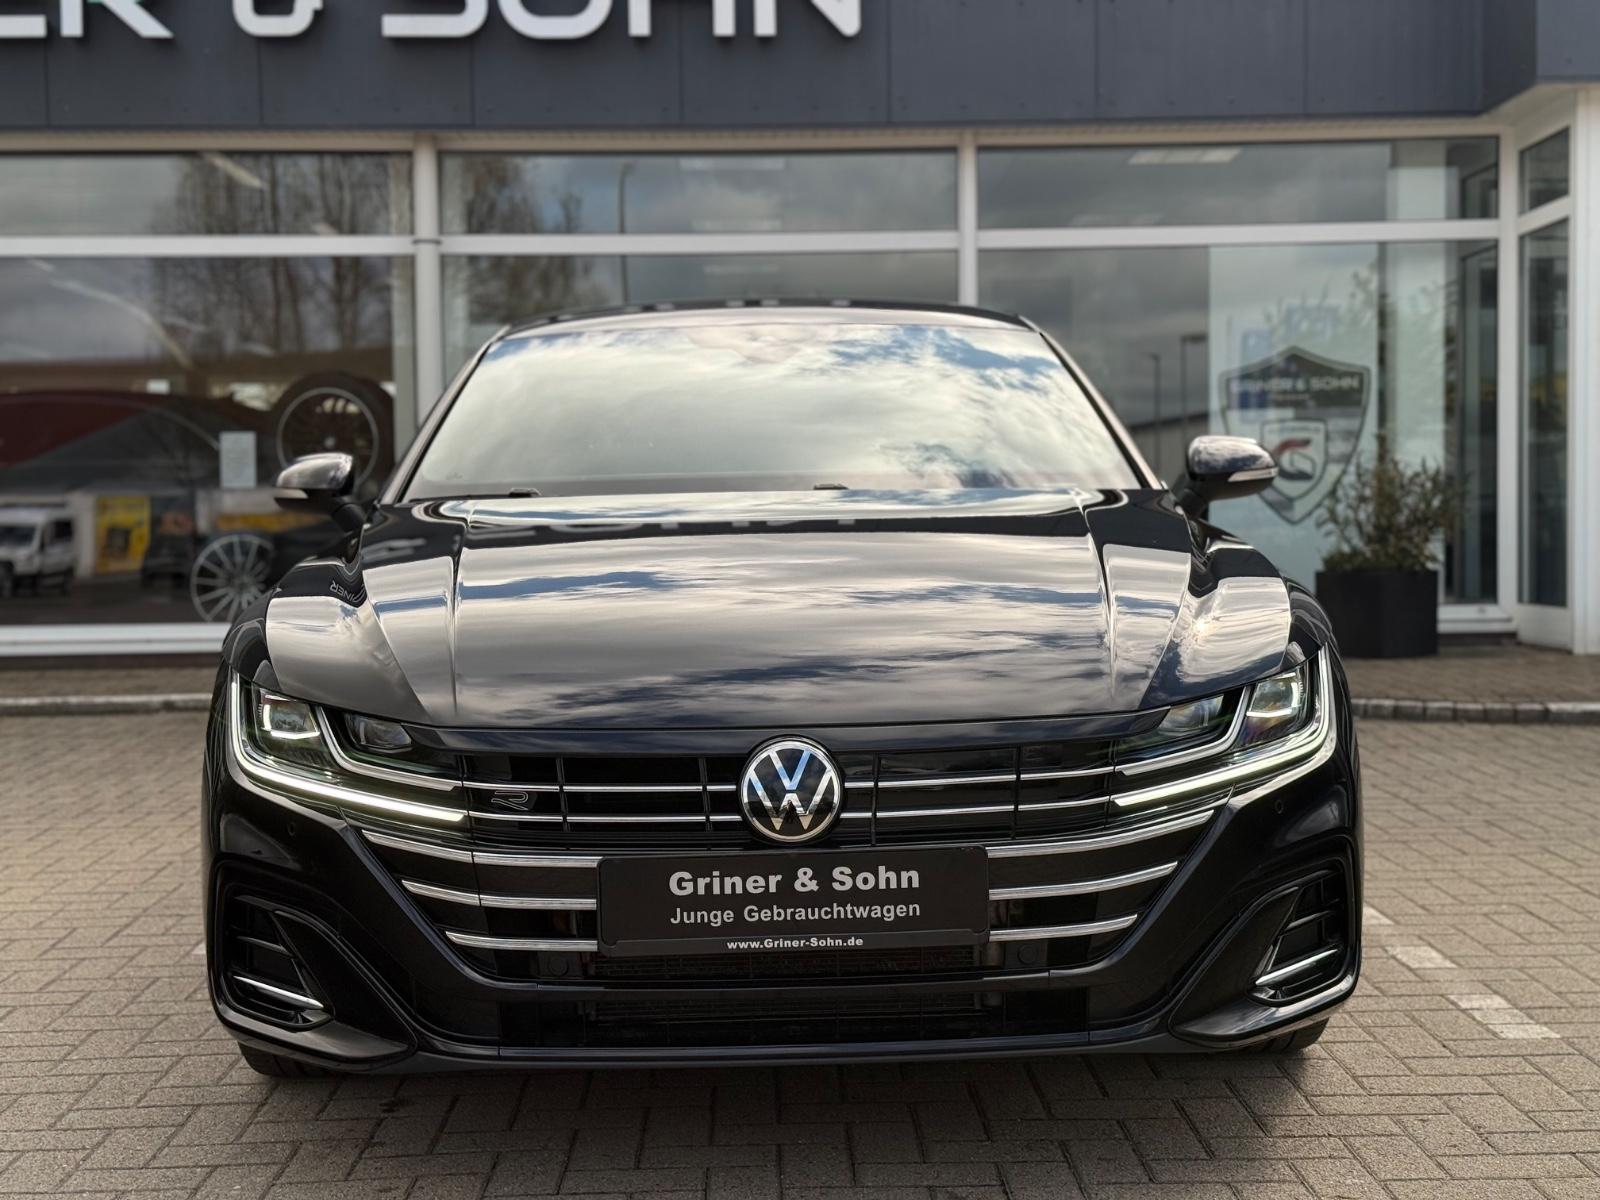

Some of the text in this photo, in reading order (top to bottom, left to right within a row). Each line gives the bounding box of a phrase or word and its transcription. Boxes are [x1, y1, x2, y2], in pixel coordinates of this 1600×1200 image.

[669, 865, 920, 896] Griner & Sohn
[670, 903, 920, 927] Junge Gebrauchtwagen
[727, 937, 863, 949] www.Griner-Sohn.de
